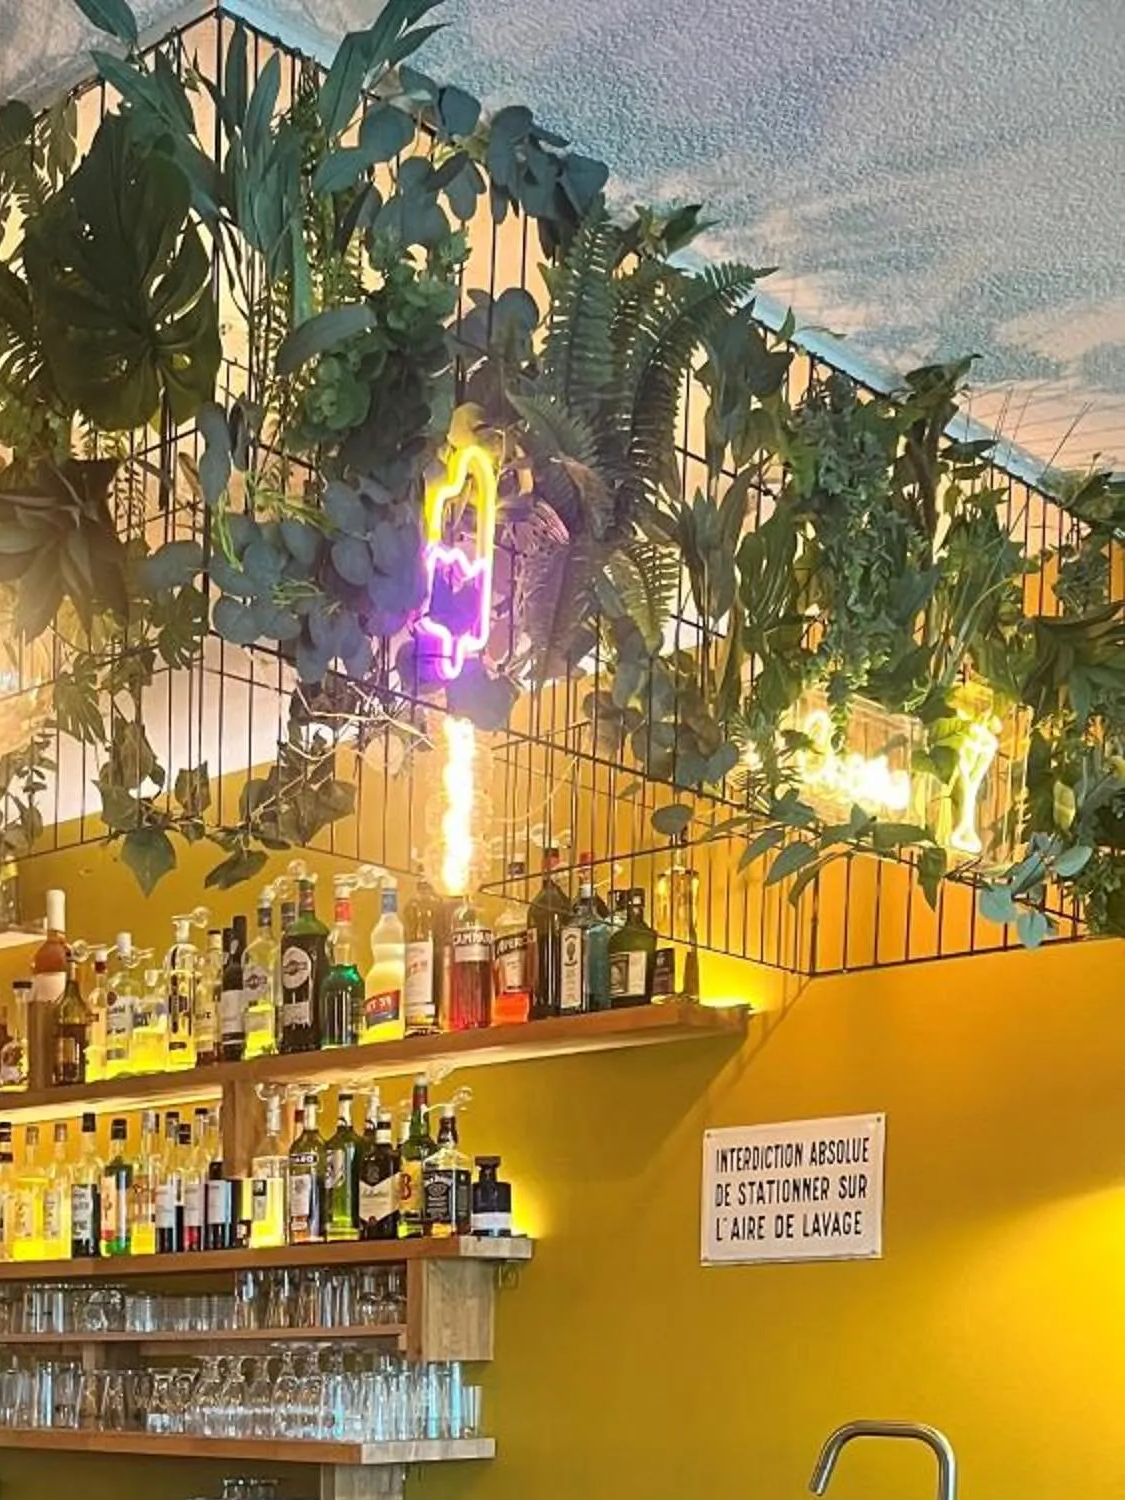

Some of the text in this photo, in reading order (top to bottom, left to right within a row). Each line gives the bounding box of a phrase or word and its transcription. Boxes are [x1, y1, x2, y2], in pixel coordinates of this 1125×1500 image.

[716, 1137, 870, 1173] INTERDICTION ABSOLUE
[715, 1173, 868, 1207] DE STATIONNER SUR
[775, 1213, 794, 1239] DE
[802, 1210, 863, 1238] LAVAGE
